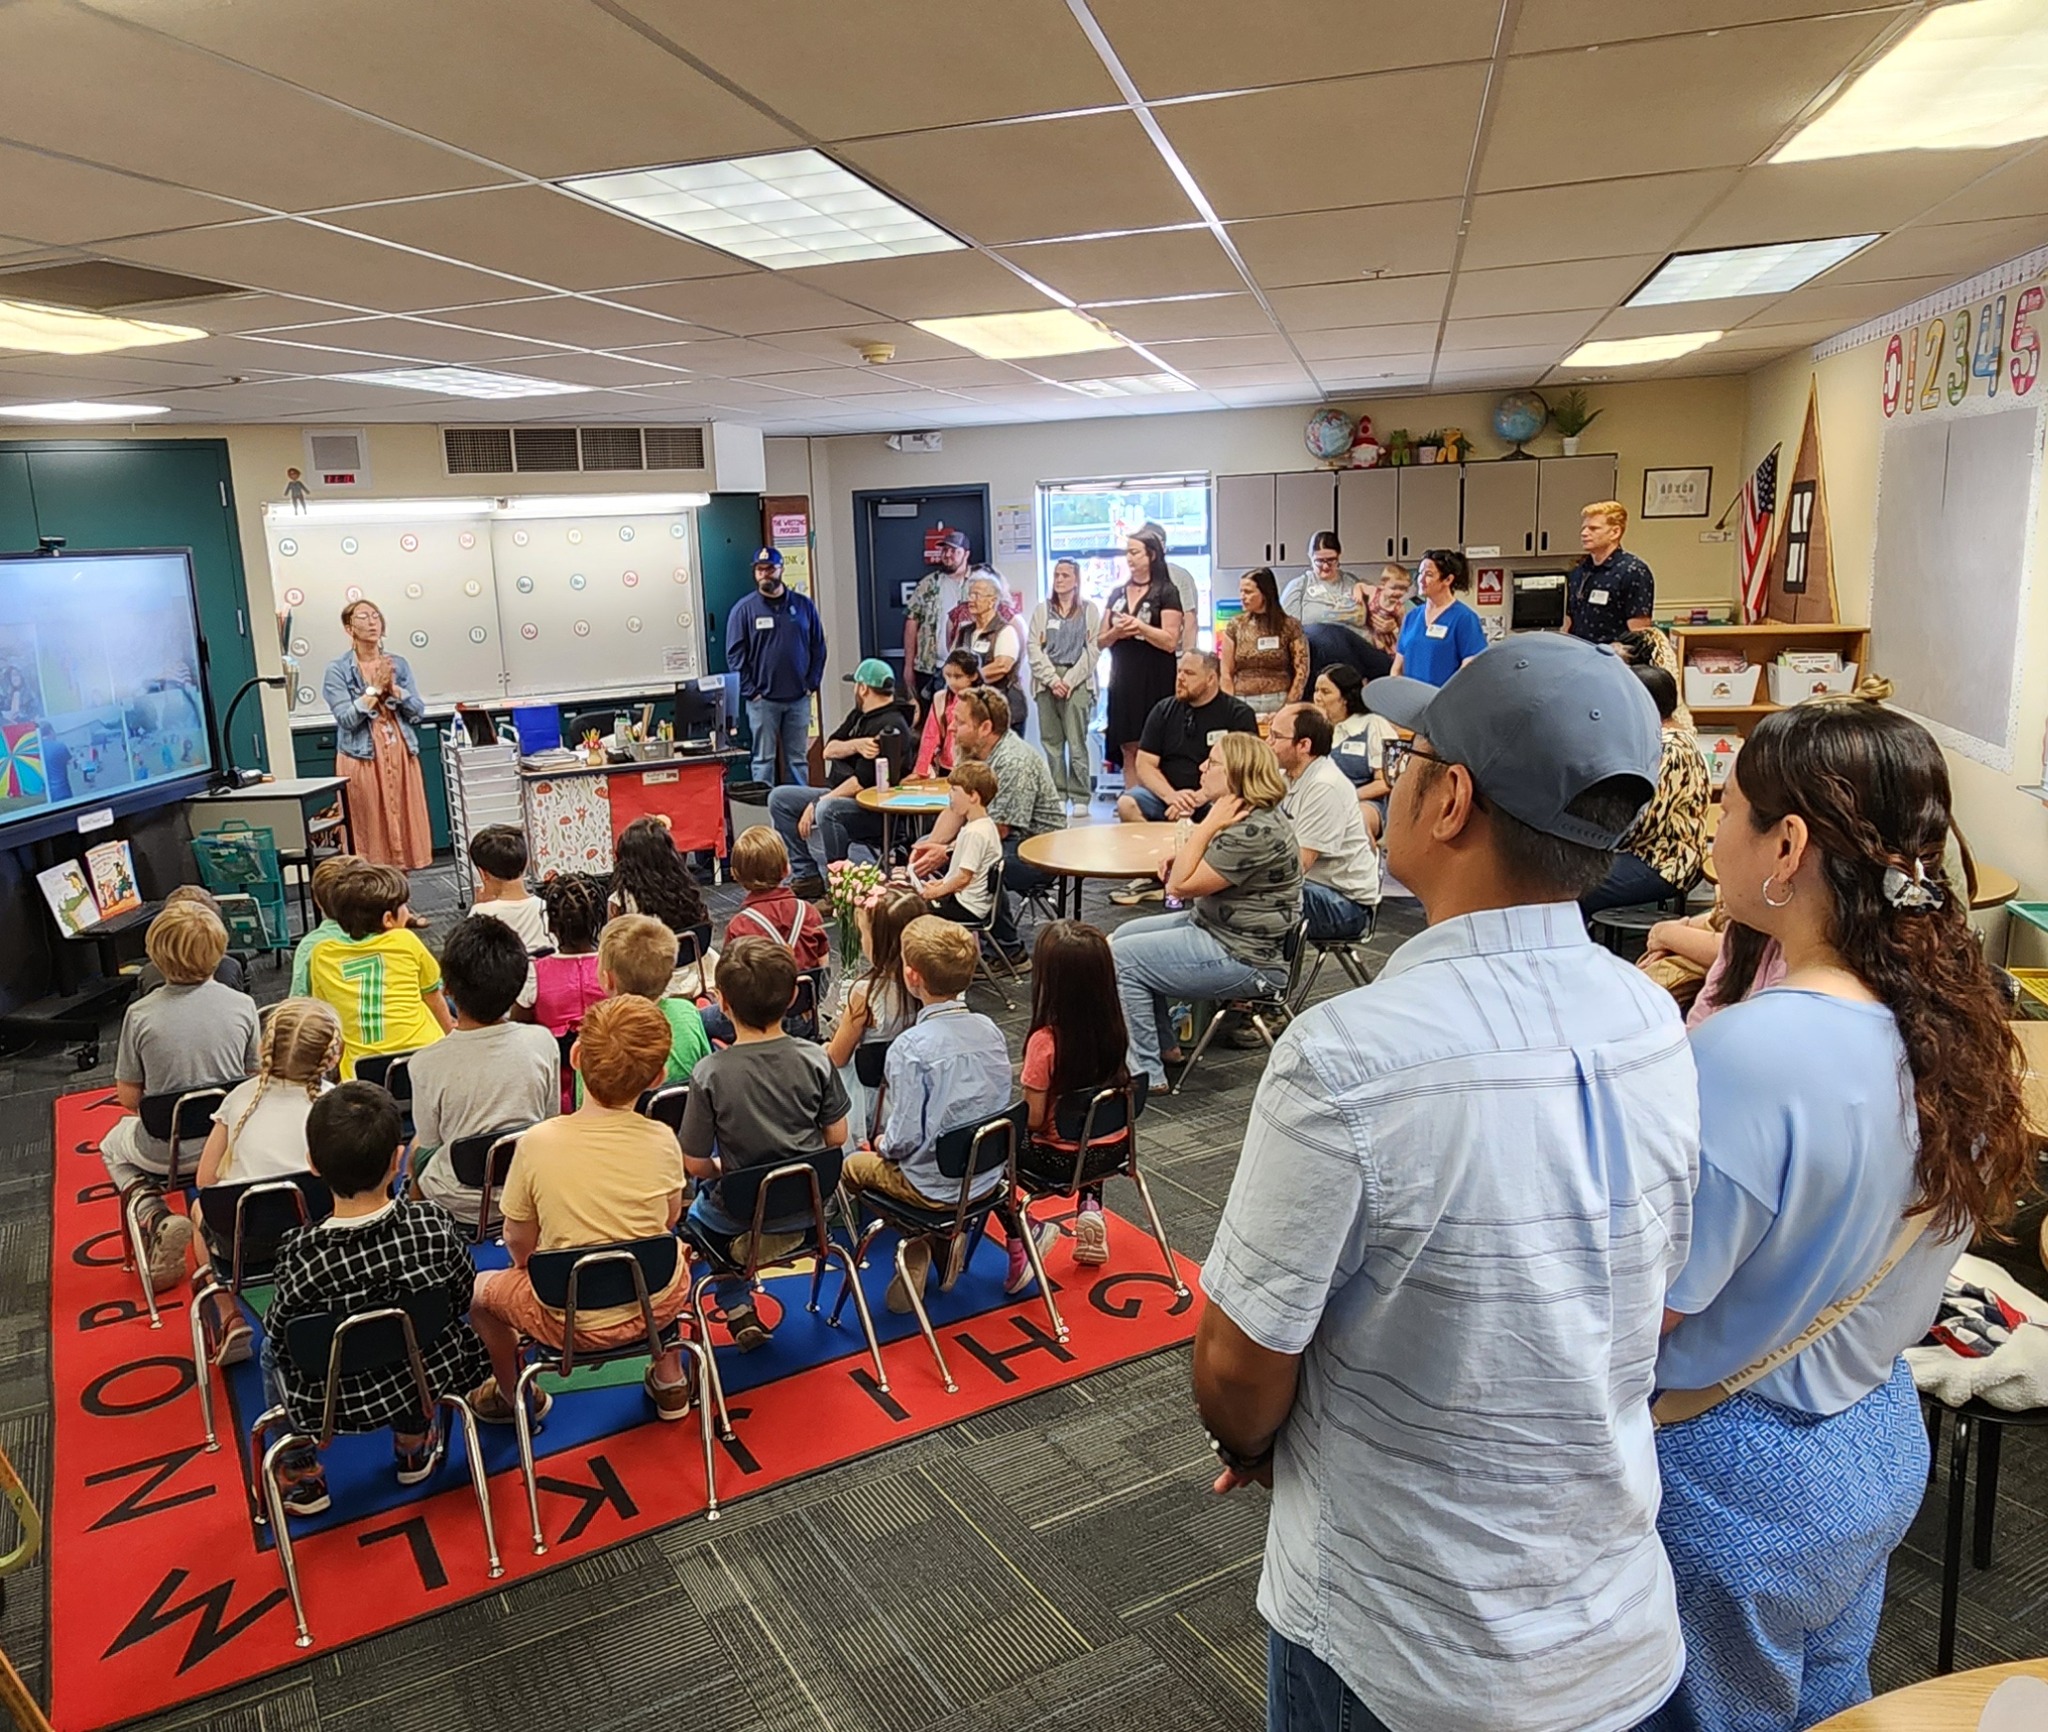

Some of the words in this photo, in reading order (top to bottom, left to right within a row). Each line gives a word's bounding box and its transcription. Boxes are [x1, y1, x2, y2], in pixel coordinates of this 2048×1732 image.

[1905, 327, 1919, 414] 1
[1920, 318, 1946, 411] 2
[1947, 310, 1971, 406] 3
[1973, 295, 2007, 397] 4
[2010, 286, 2046, 396] 5
[341, 952, 384, 1045] 7
[1088, 1272, 1194, 1319] G
[951, 1315, 1079, 1385] H
[84, 1441, 217, 1534] N
[520, 1455, 640, 1546] K
[357, 1515, 449, 1592] L
[100, 1567, 290, 1678] M
